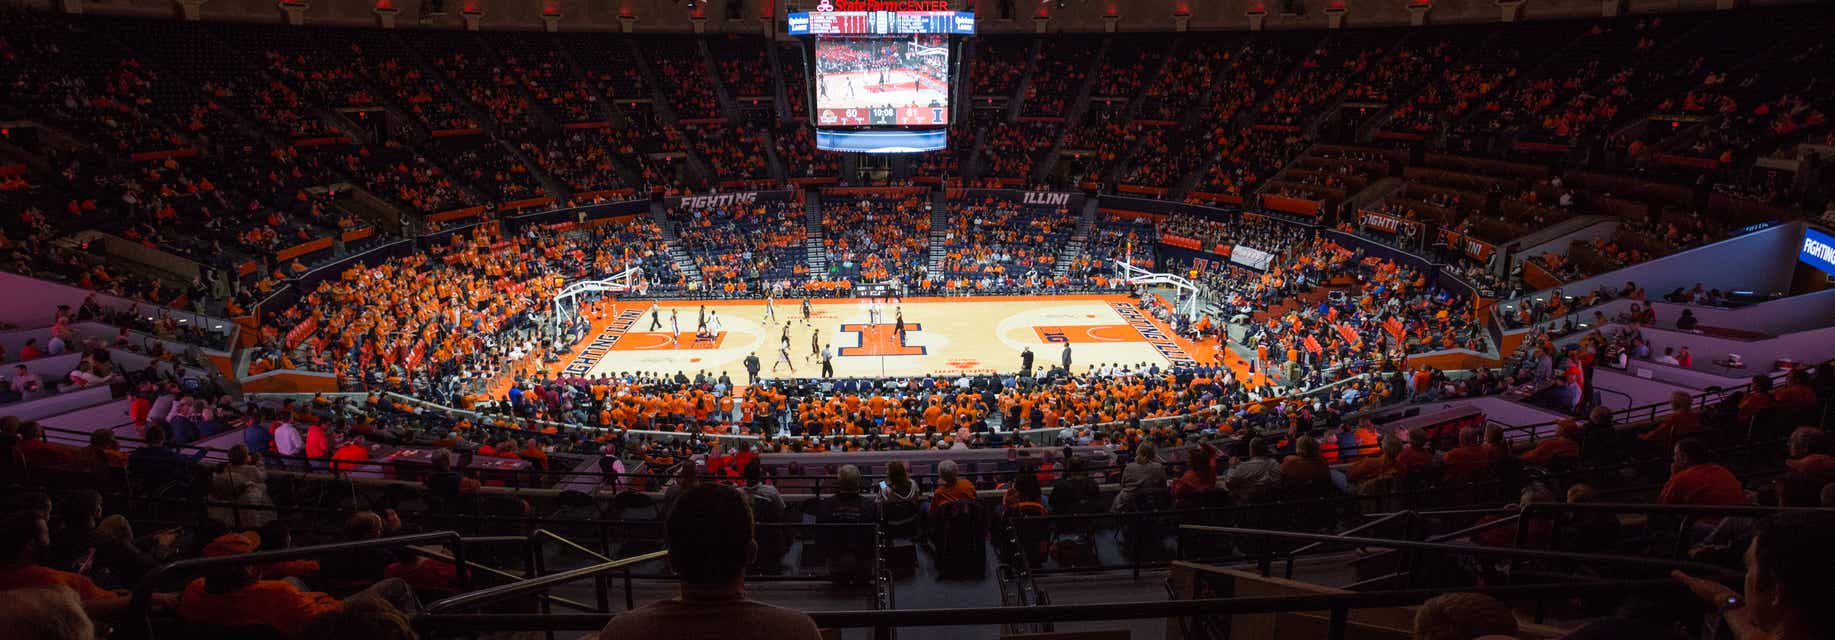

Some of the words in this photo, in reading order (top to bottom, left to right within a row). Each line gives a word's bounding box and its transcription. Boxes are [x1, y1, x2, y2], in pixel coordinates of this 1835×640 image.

[899, 1, 948, 11] CENTER
[680, 192, 758, 209] FIGHTING
[1023, 192, 1071, 206] ILLINI
